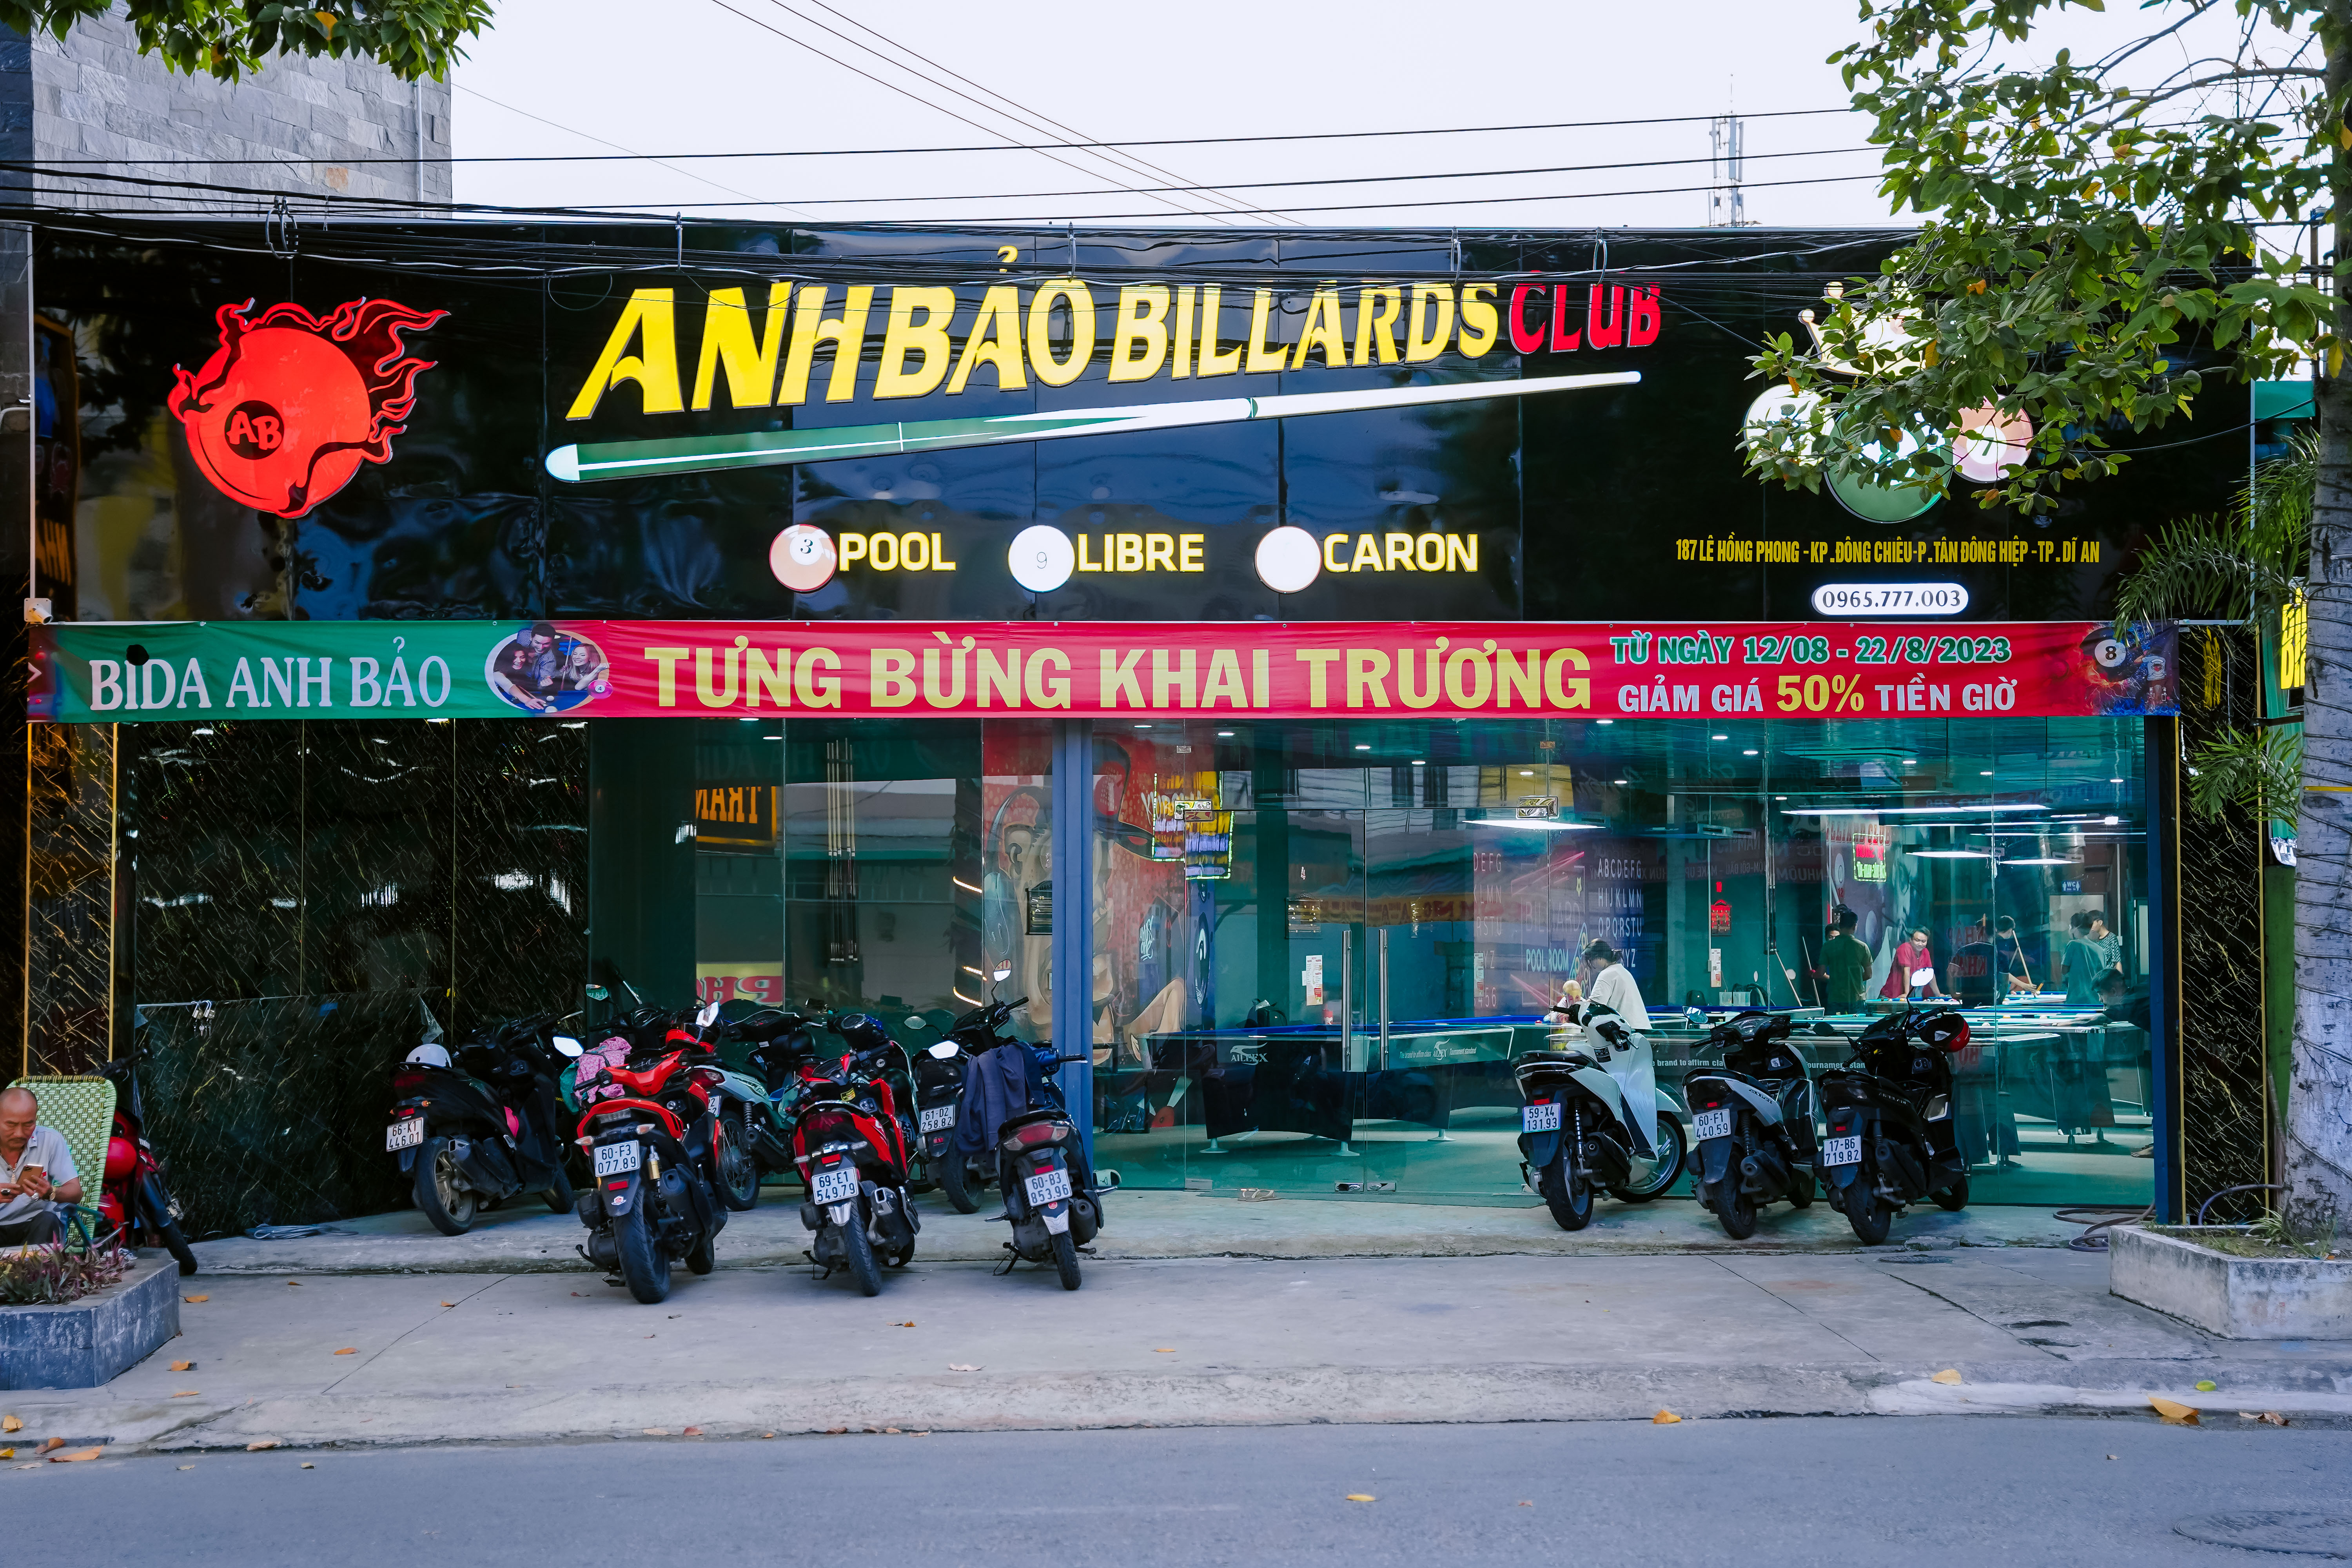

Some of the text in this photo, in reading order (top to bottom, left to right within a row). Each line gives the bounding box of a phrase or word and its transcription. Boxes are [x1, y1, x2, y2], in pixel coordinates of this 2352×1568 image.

[1108, 280, 1499, 383] BILLARDS
[1509, 270, 1661, 354] CLUB
[227, 412, 282, 450] AB
[1982, 437, 1994, 456] 7
[800, 532, 956, 572] 3 POOL
[1036, 533, 1204, 572] 9 LIBRE
[1324, 533, 1478, 573] CARON
[1676, 539, 1697, 560] 187
[1699, 535, 1713, 561] LÊ
[1717, 532, 1753, 562] HỒNG
[1756, 541, 1799, 563] PHONG
[1960, 535, 1996, 563] ĐÔNG
[1999, 535, 2028, 566] HIỆP
[2063, 537, 2078, 563] DĨ
[2080, 541, 2100, 563] AN
[1822, 590, 1961, 608] 0965.777.003
[1610, 630, 1649, 664] TỪ
[1658, 630, 1735, 664] NGÀY
[1744, 635, 1829, 665] 12/08
[1856, 635, 2012, 664] 22/8/2023
[2105, 646, 2116, 660] 8
[90, 636, 450, 711] BIDA ANH BẢO
[644, 632, 1591, 709] TƯNG BỪNG KHAI TRƯƠNG
[1618, 674, 2018, 713] GIẢM GIÁ 50% TIỀN GIỜ
[1526, 948, 1569, 973] POOL ROOM
[926, 1107, 949, 1120] 61-D2
[1529, 1106, 1555, 1119] 59-X4
[1699, 1112, 1723, 1127] 60-F1
[393, 1121, 416, 1136] 66-K1
[922, 1116, 952, 1132] 258.82
[1527, 1117, 1557, 1131] 131.93
[1696, 1123, 1728, 1139] 440.59
[389, 1132, 419, 1149] 446.01
[1829, 1138, 1855, 1152] 17-B6
[602, 1144, 631, 1160] 60-F3
[1825, 1149, 1859, 1165] 719.82
[598, 1156, 636, 1174] 077.89
[819, 1171, 848, 1188] 69-E1
[1032, 1172, 1062, 1190] 60-B3
[817, 1183, 855, 1201] 549.79
[1031, 1184, 1069, 1203] 853.96
